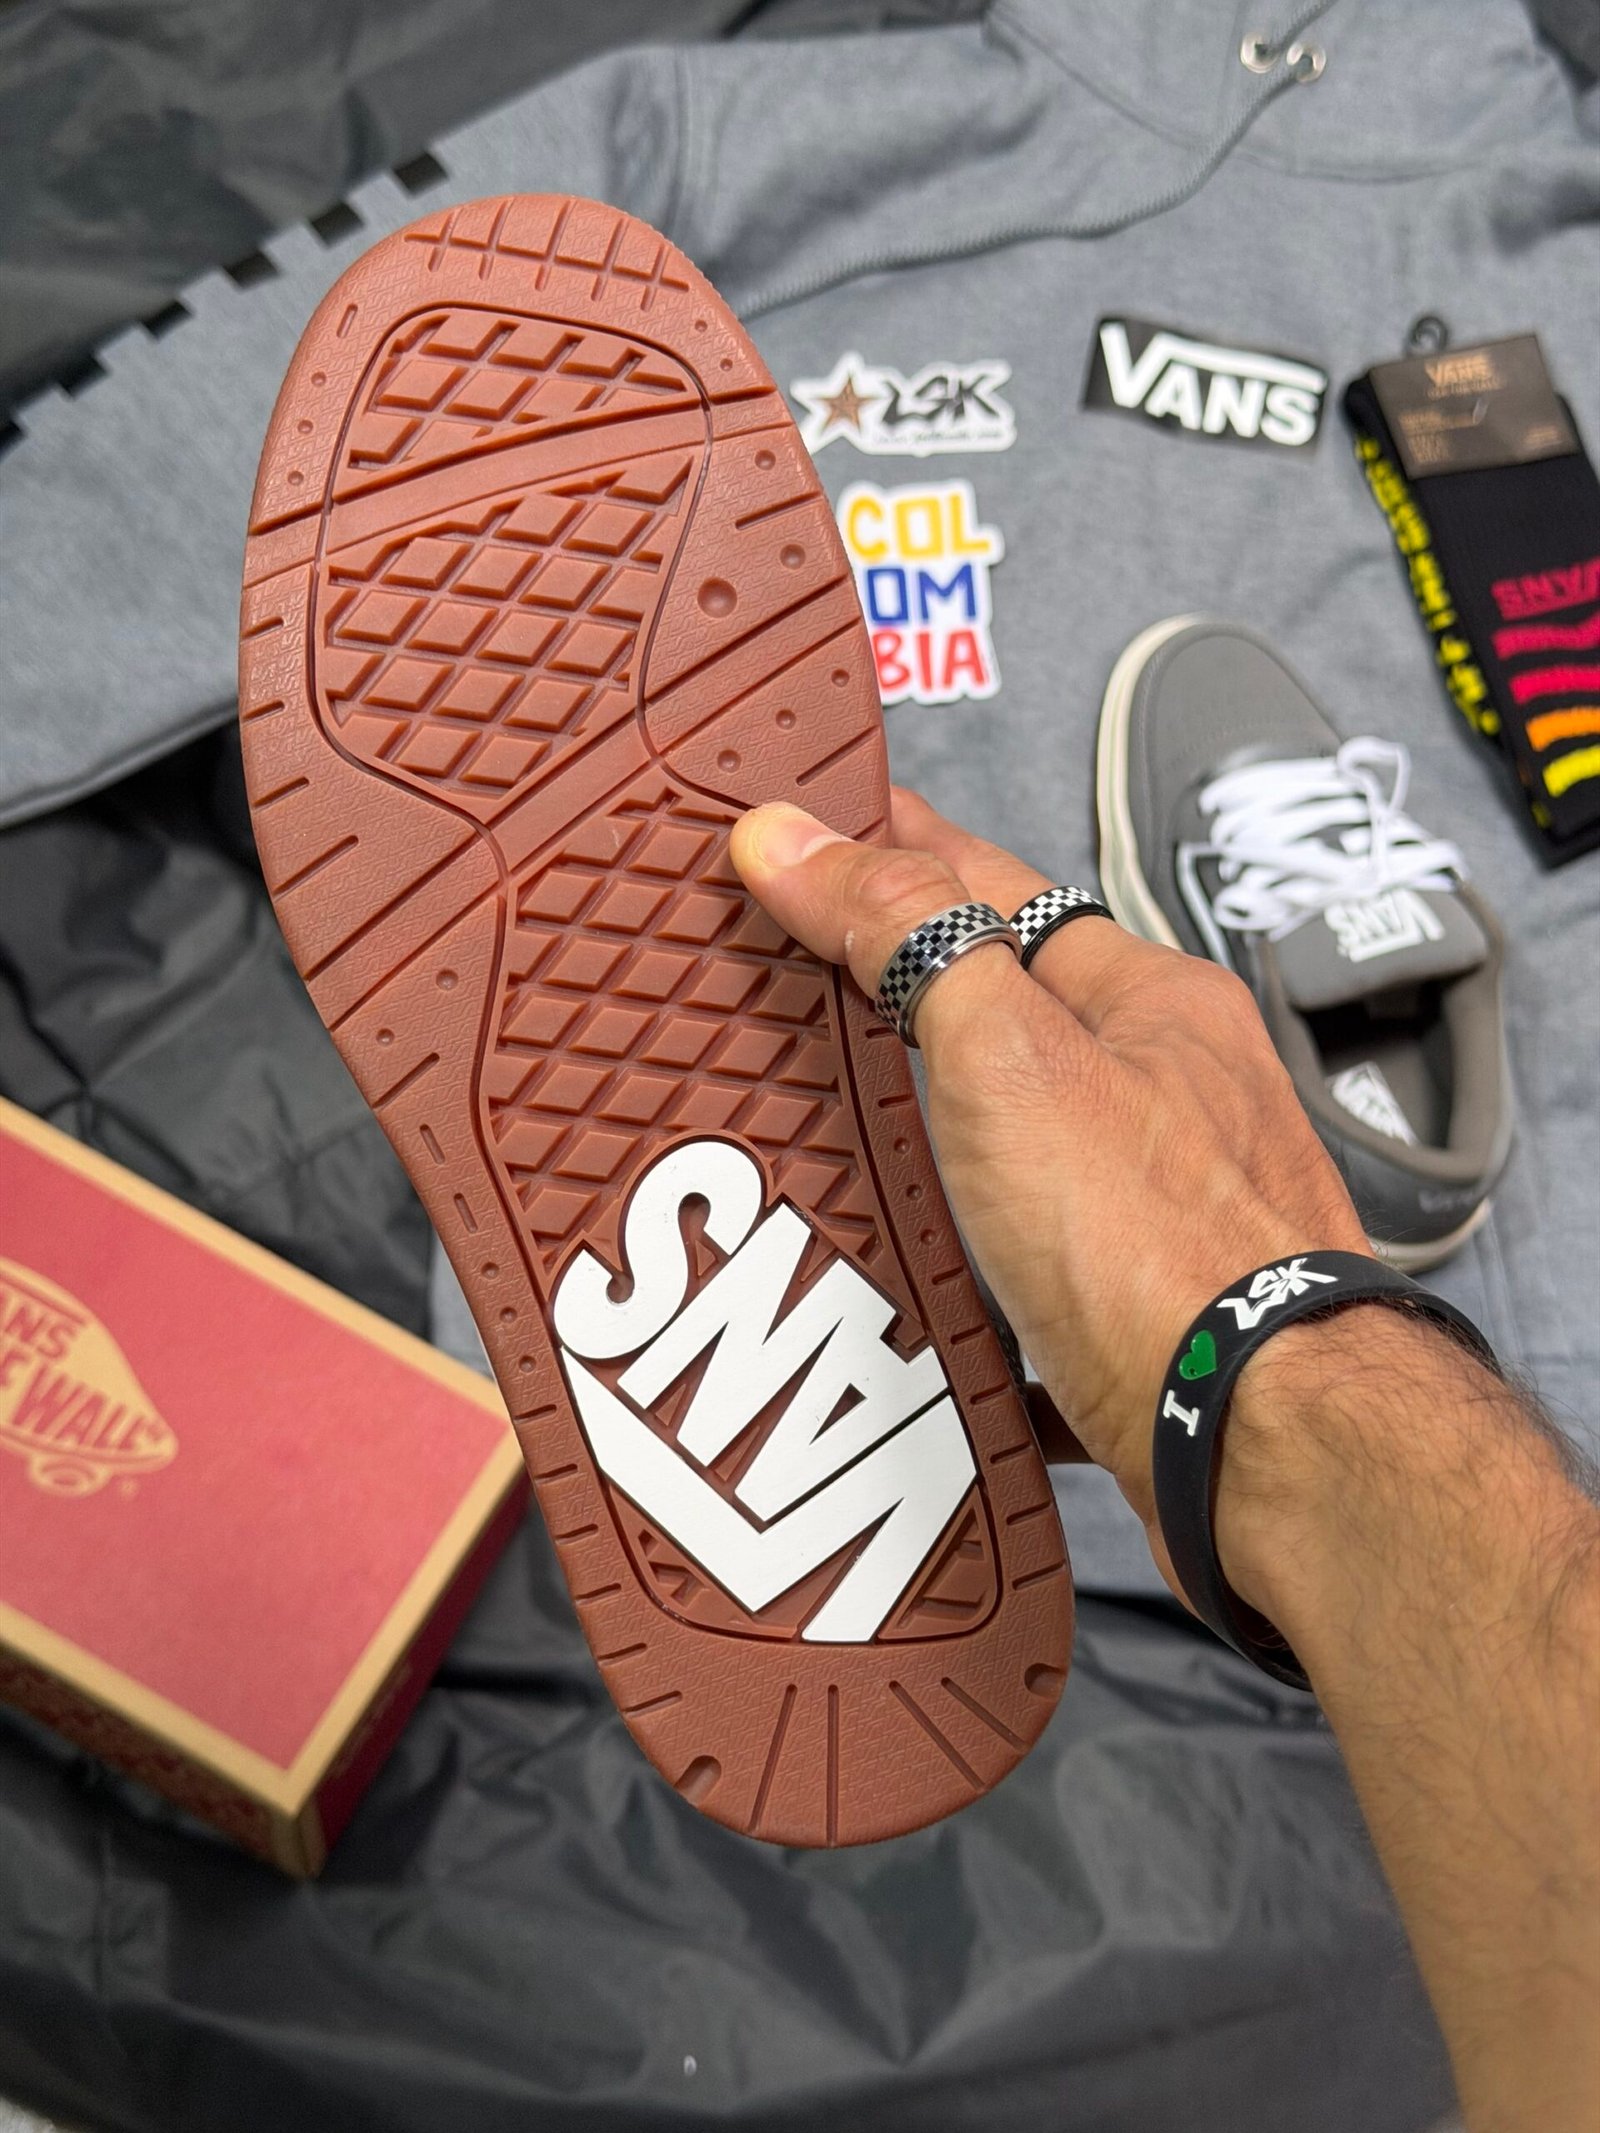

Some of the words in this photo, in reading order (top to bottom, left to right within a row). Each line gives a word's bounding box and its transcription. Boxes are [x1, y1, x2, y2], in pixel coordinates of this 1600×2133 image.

[1099, 321, 1328, 446] VANS
[847, 492, 991, 561] COL
[866, 563, 977, 625] OM
[873, 630, 989, 691] BIA
[1323, 888, 1446, 964] VANS
[553, 1140, 978, 1643] VANS
[1162, 1389, 1201, 1437] I
